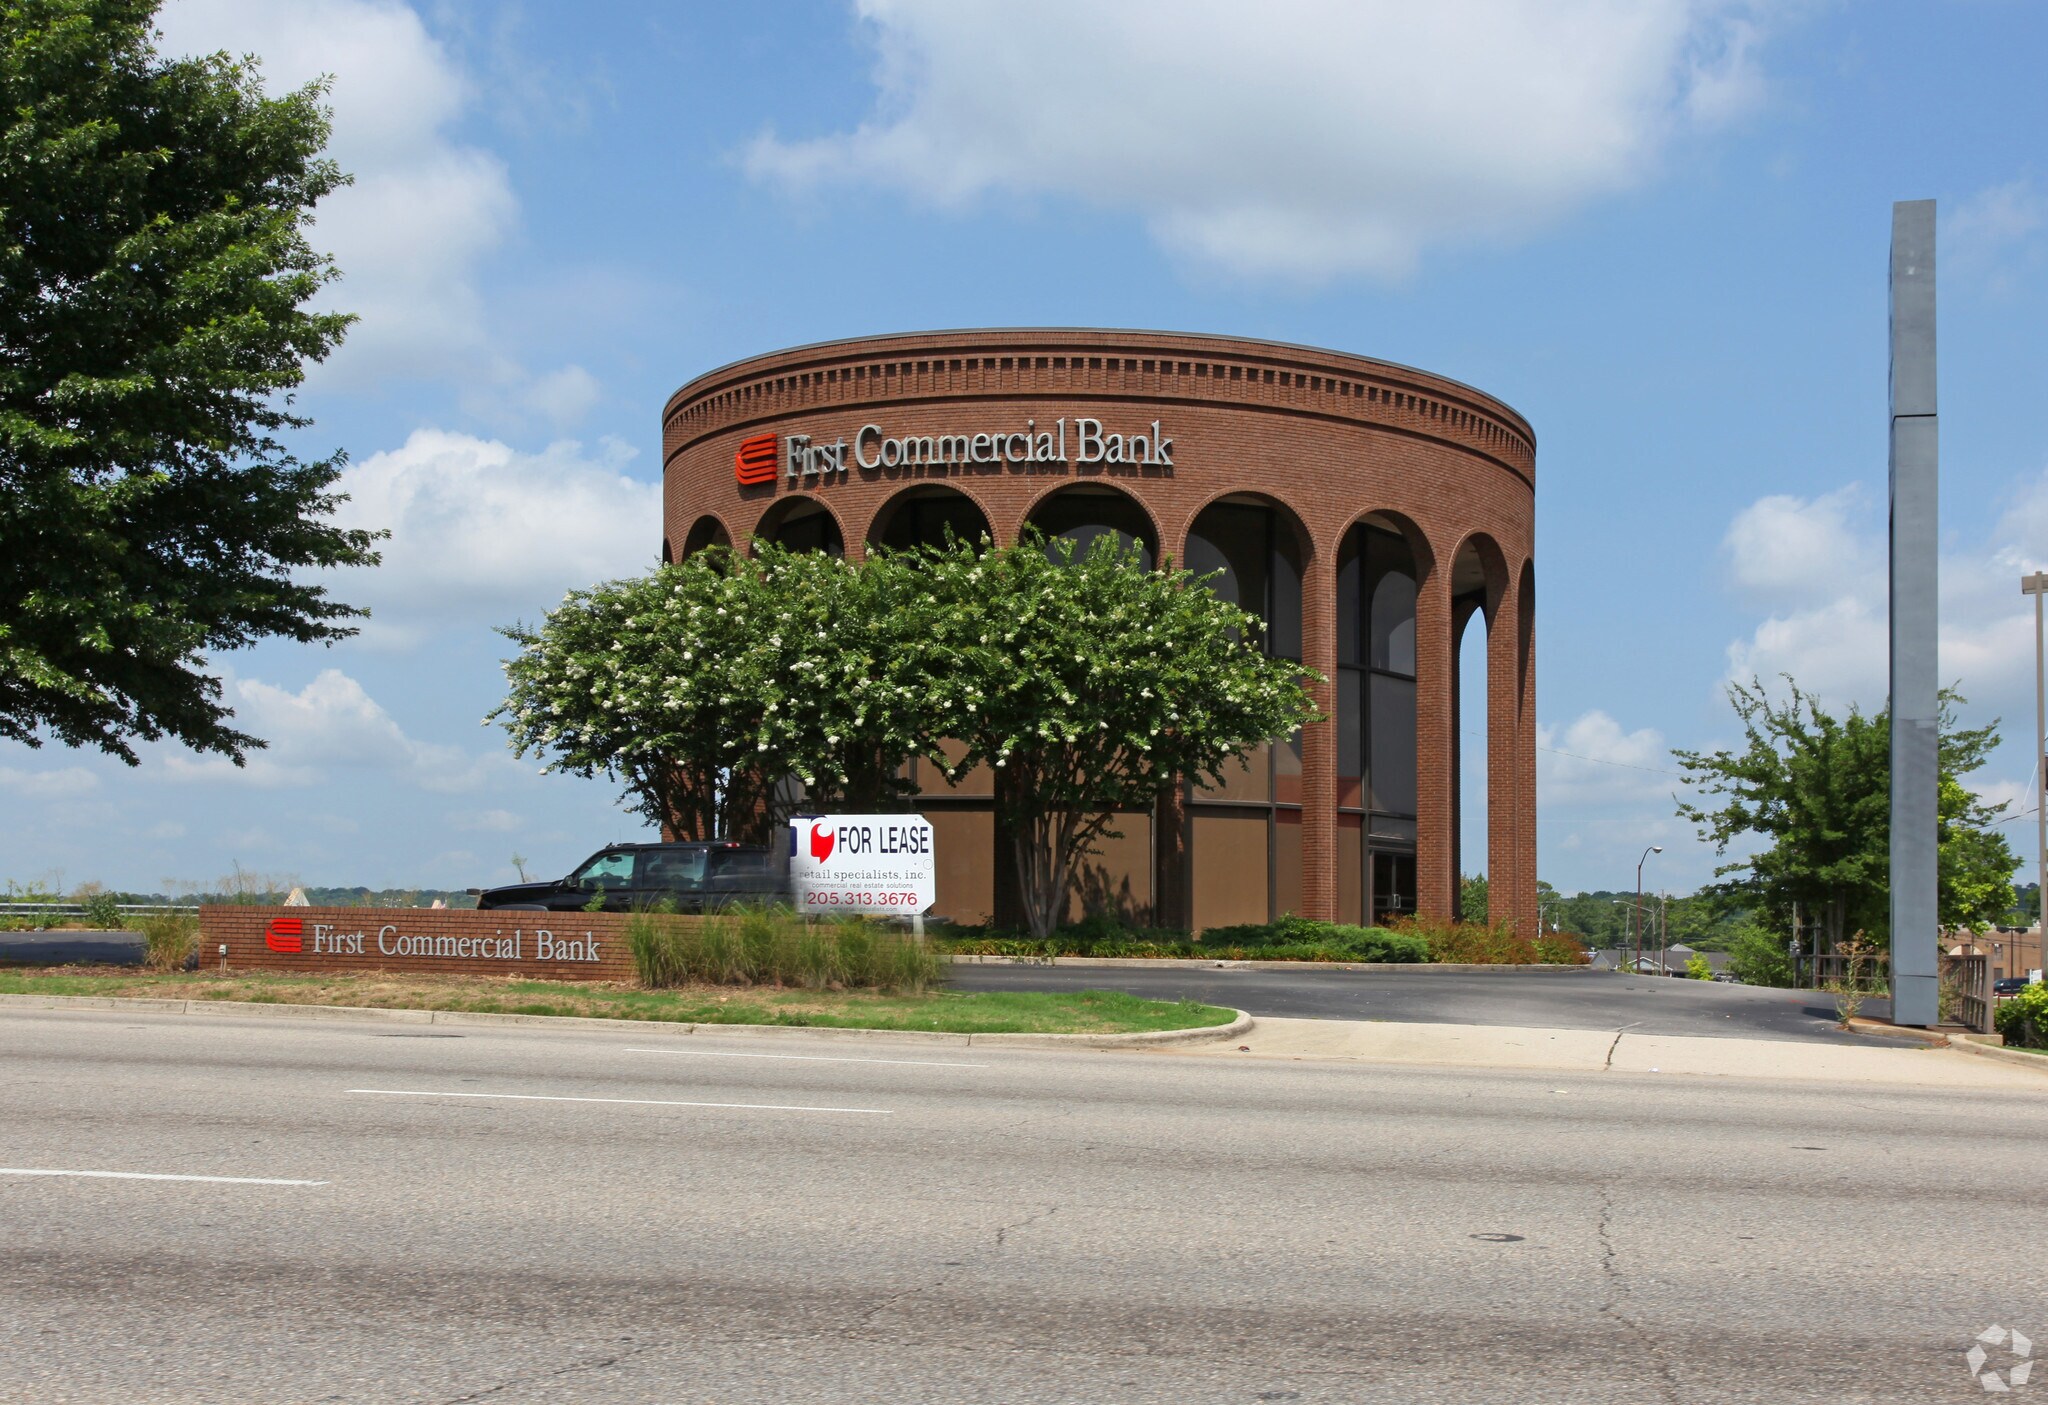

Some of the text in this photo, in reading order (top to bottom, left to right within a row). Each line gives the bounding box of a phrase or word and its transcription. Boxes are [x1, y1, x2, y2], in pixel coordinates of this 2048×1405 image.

[784, 417, 1174, 478] First Commercial Bank
[838, 826, 929, 854] FOR LEASE
[799, 869, 927, 881] retail specialists, inc.
[807, 892, 918, 905] 205.313.3676
[312, 924, 600, 962] First Commercial Bank
